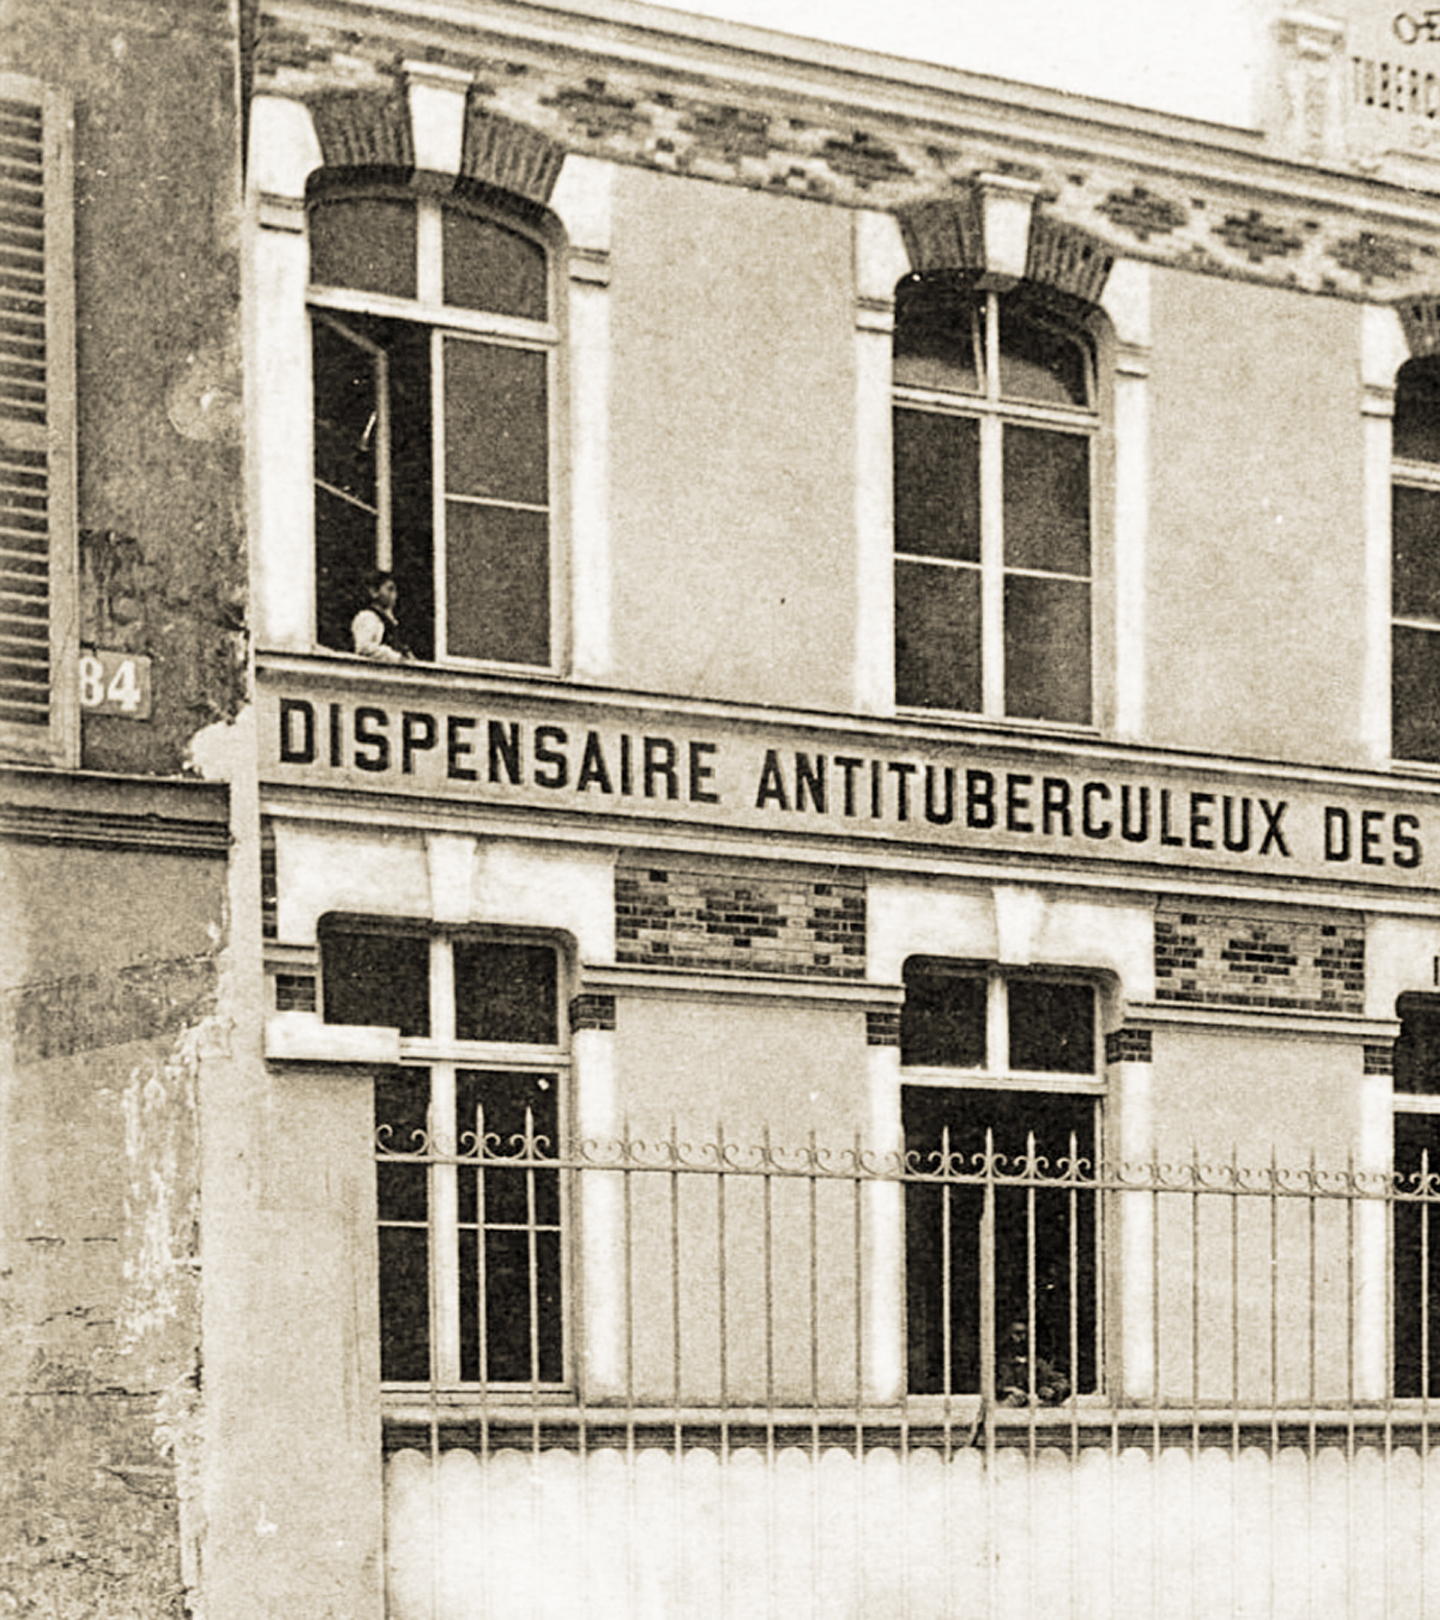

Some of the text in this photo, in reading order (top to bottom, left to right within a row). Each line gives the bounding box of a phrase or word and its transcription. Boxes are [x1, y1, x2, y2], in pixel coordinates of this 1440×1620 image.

[79, 656, 141, 712] 84
[278, 697, 722, 804] DISPENSAIRE
[754, 748, 1290, 858] ANTITUBERCULEUX
[1324, 806, 1422, 869] DES
